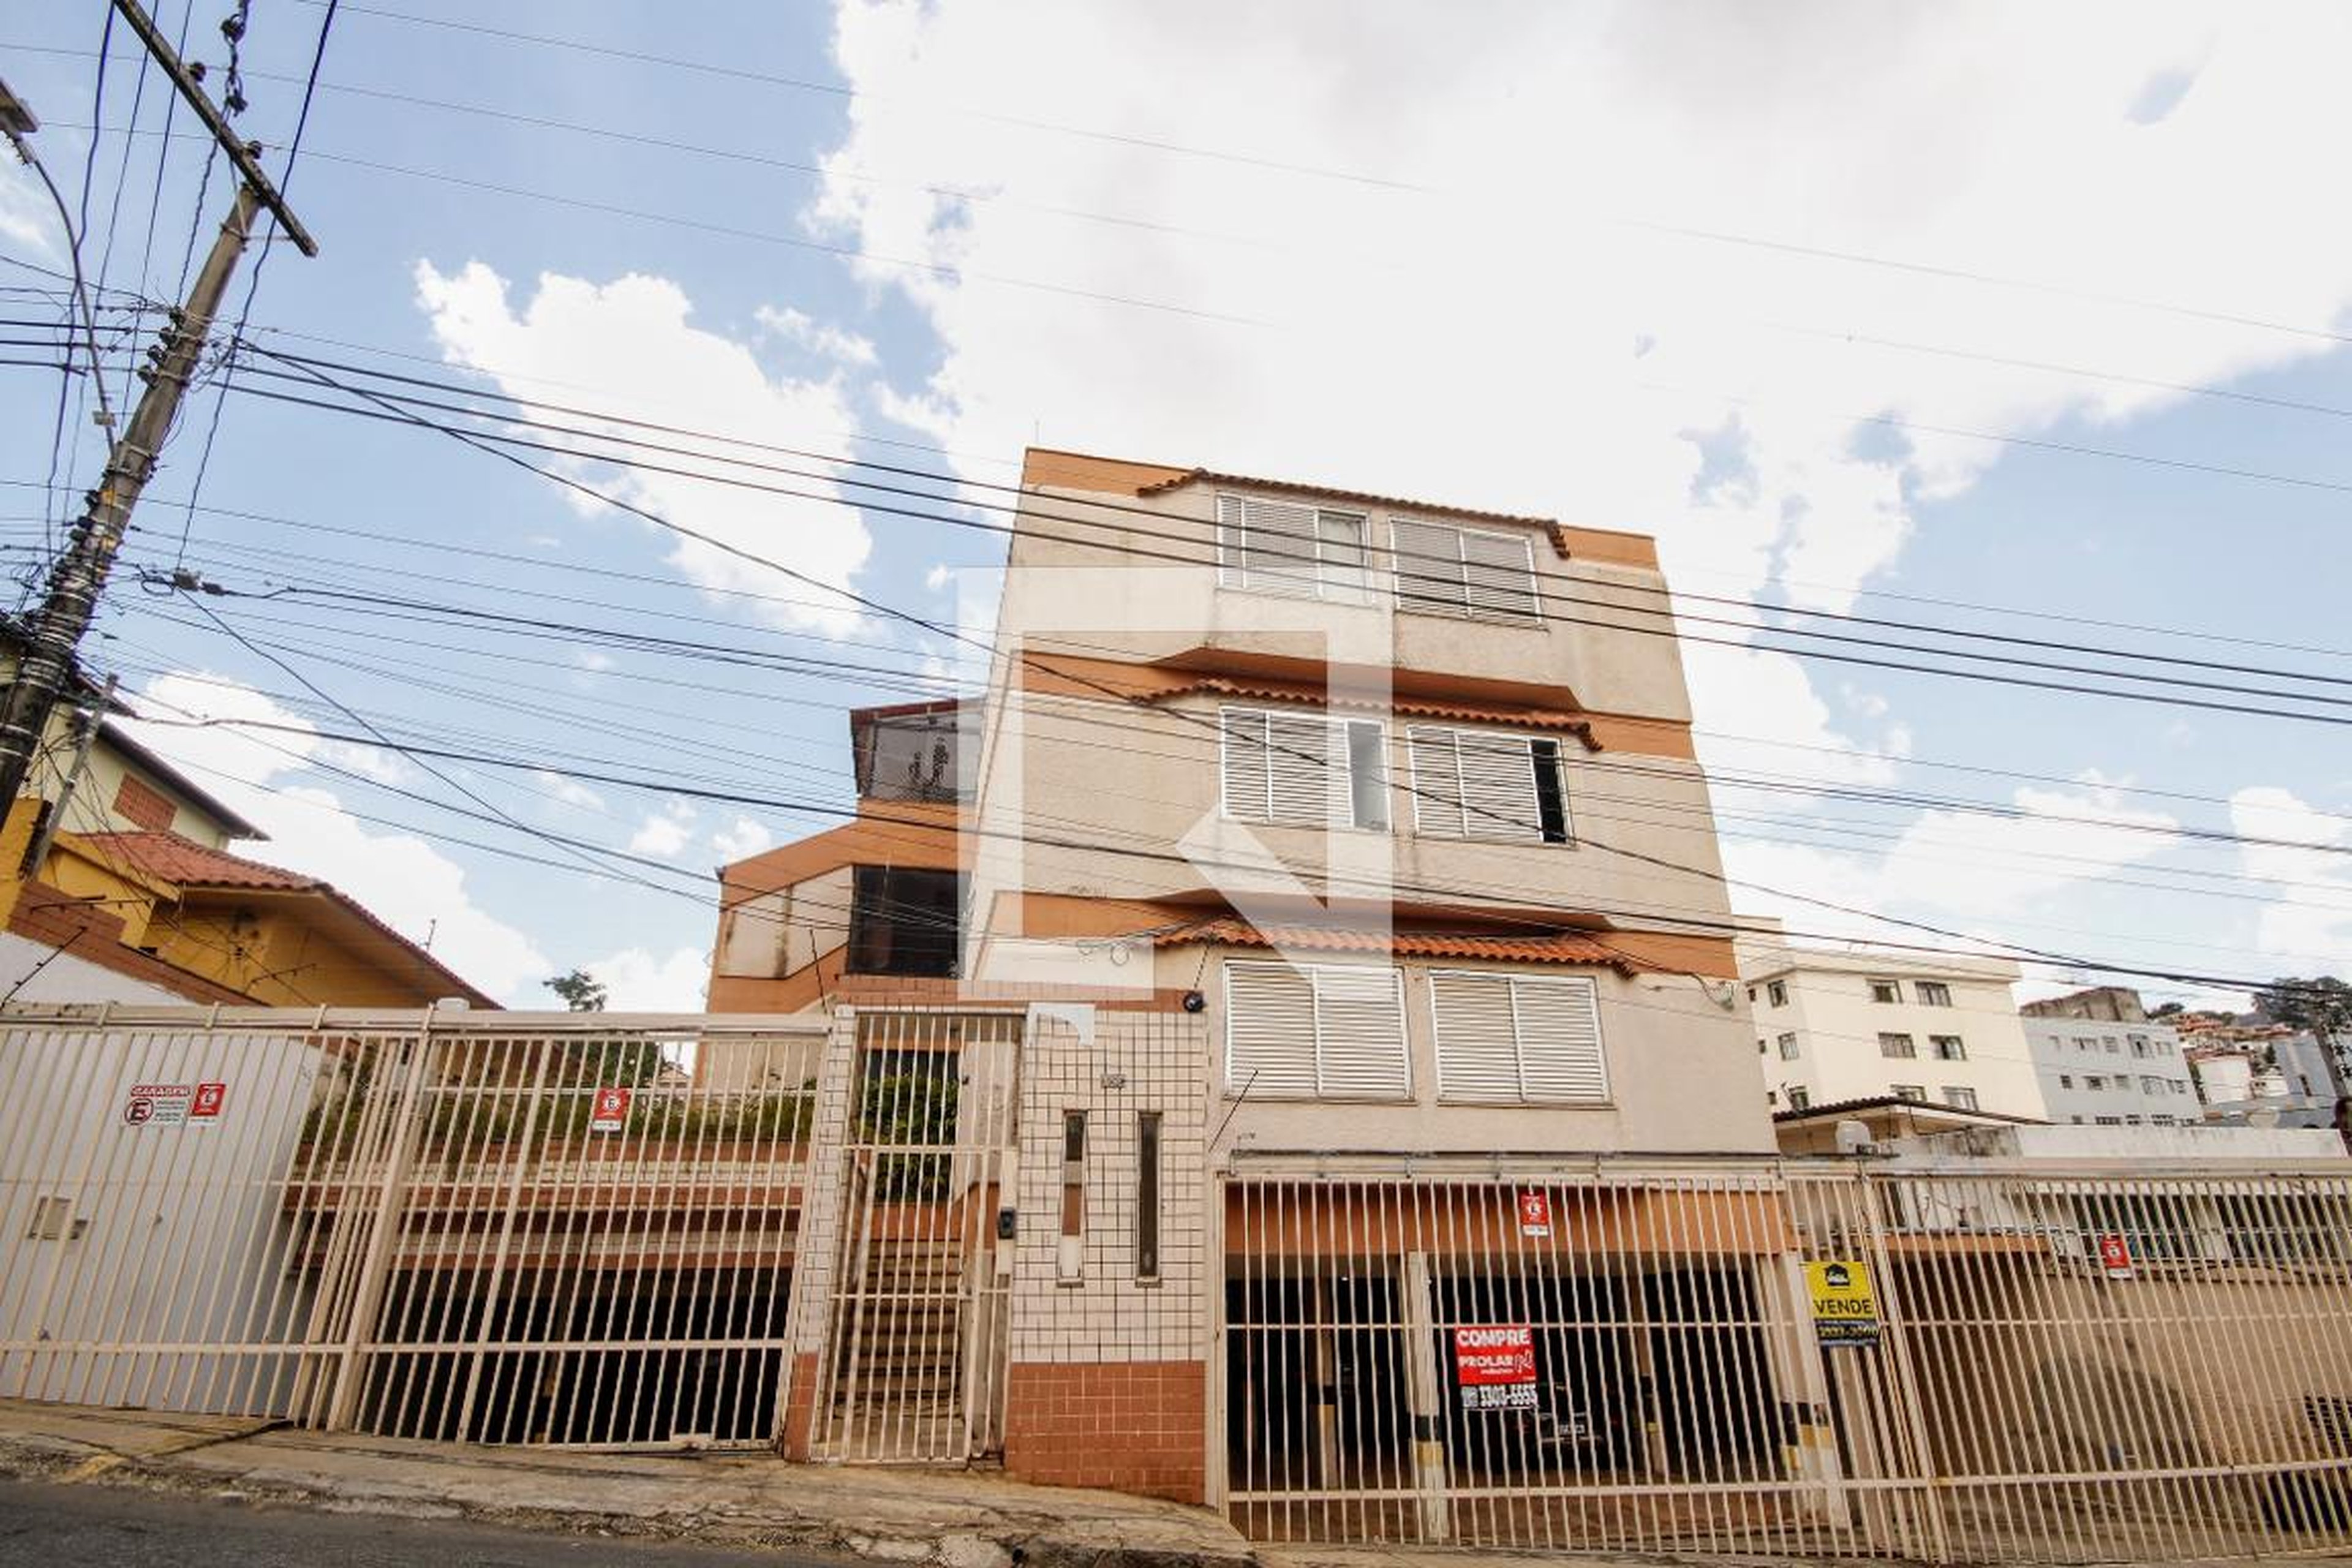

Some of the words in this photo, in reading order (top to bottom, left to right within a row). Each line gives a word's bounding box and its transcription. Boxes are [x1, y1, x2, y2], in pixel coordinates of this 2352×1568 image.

[1813, 1298, 1874, 1314] VENDE
[1457, 1328, 1531, 1347] COMPRE
[1458, 1354, 1513, 1368] PROLAR
